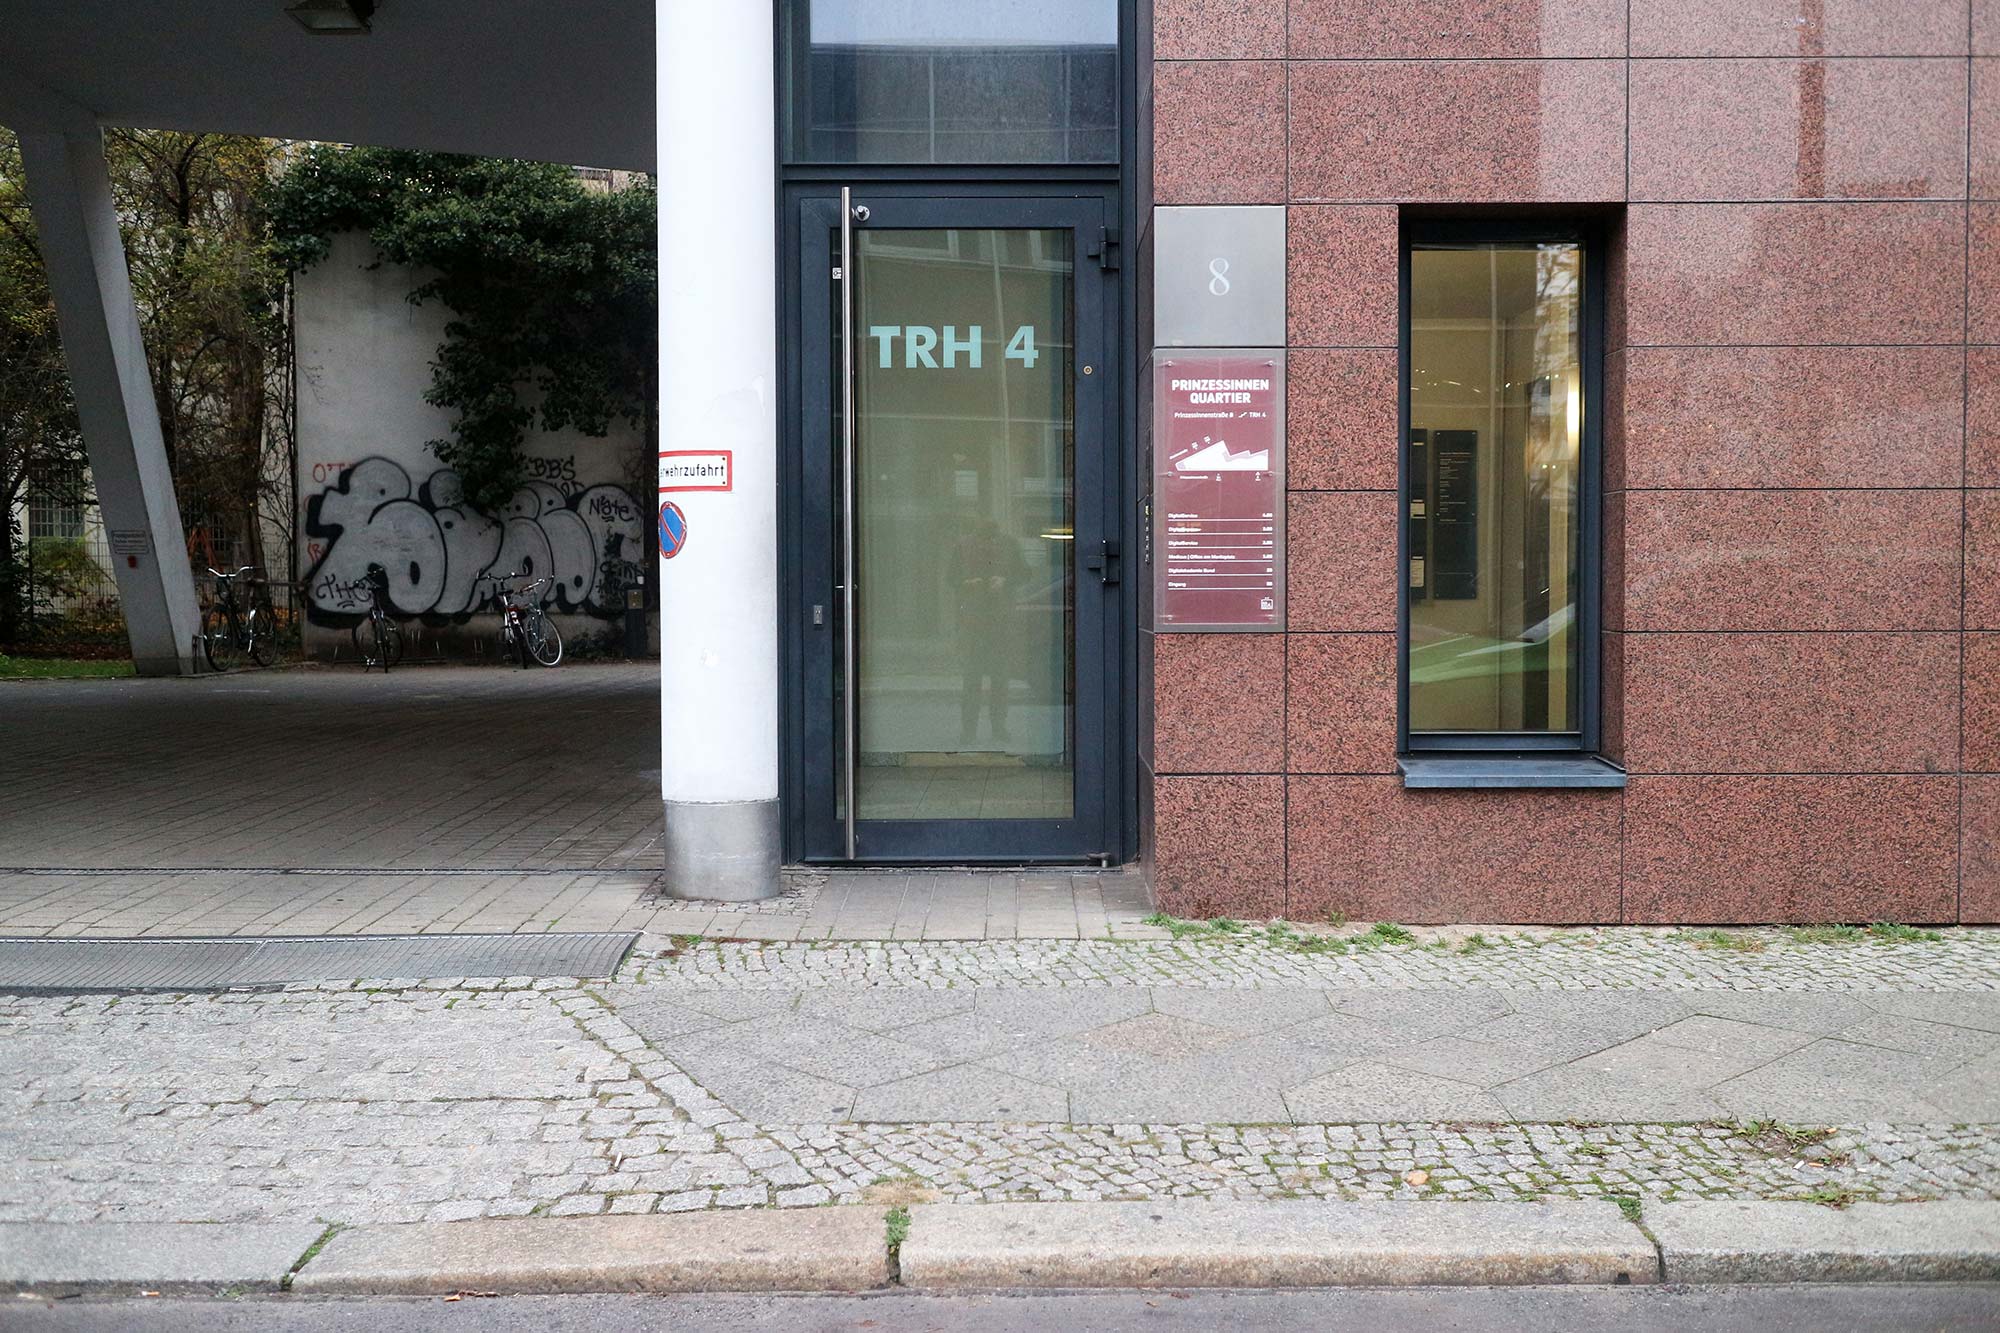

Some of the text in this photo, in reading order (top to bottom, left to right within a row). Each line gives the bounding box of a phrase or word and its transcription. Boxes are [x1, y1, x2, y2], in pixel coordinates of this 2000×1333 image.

[1208, 257, 1231, 296] 8
[870, 325, 1039, 369] TRH 4
[1171, 379, 1270, 391] PRINZESSINNEN
[1189, 392, 1252, 404] QUARTIER
